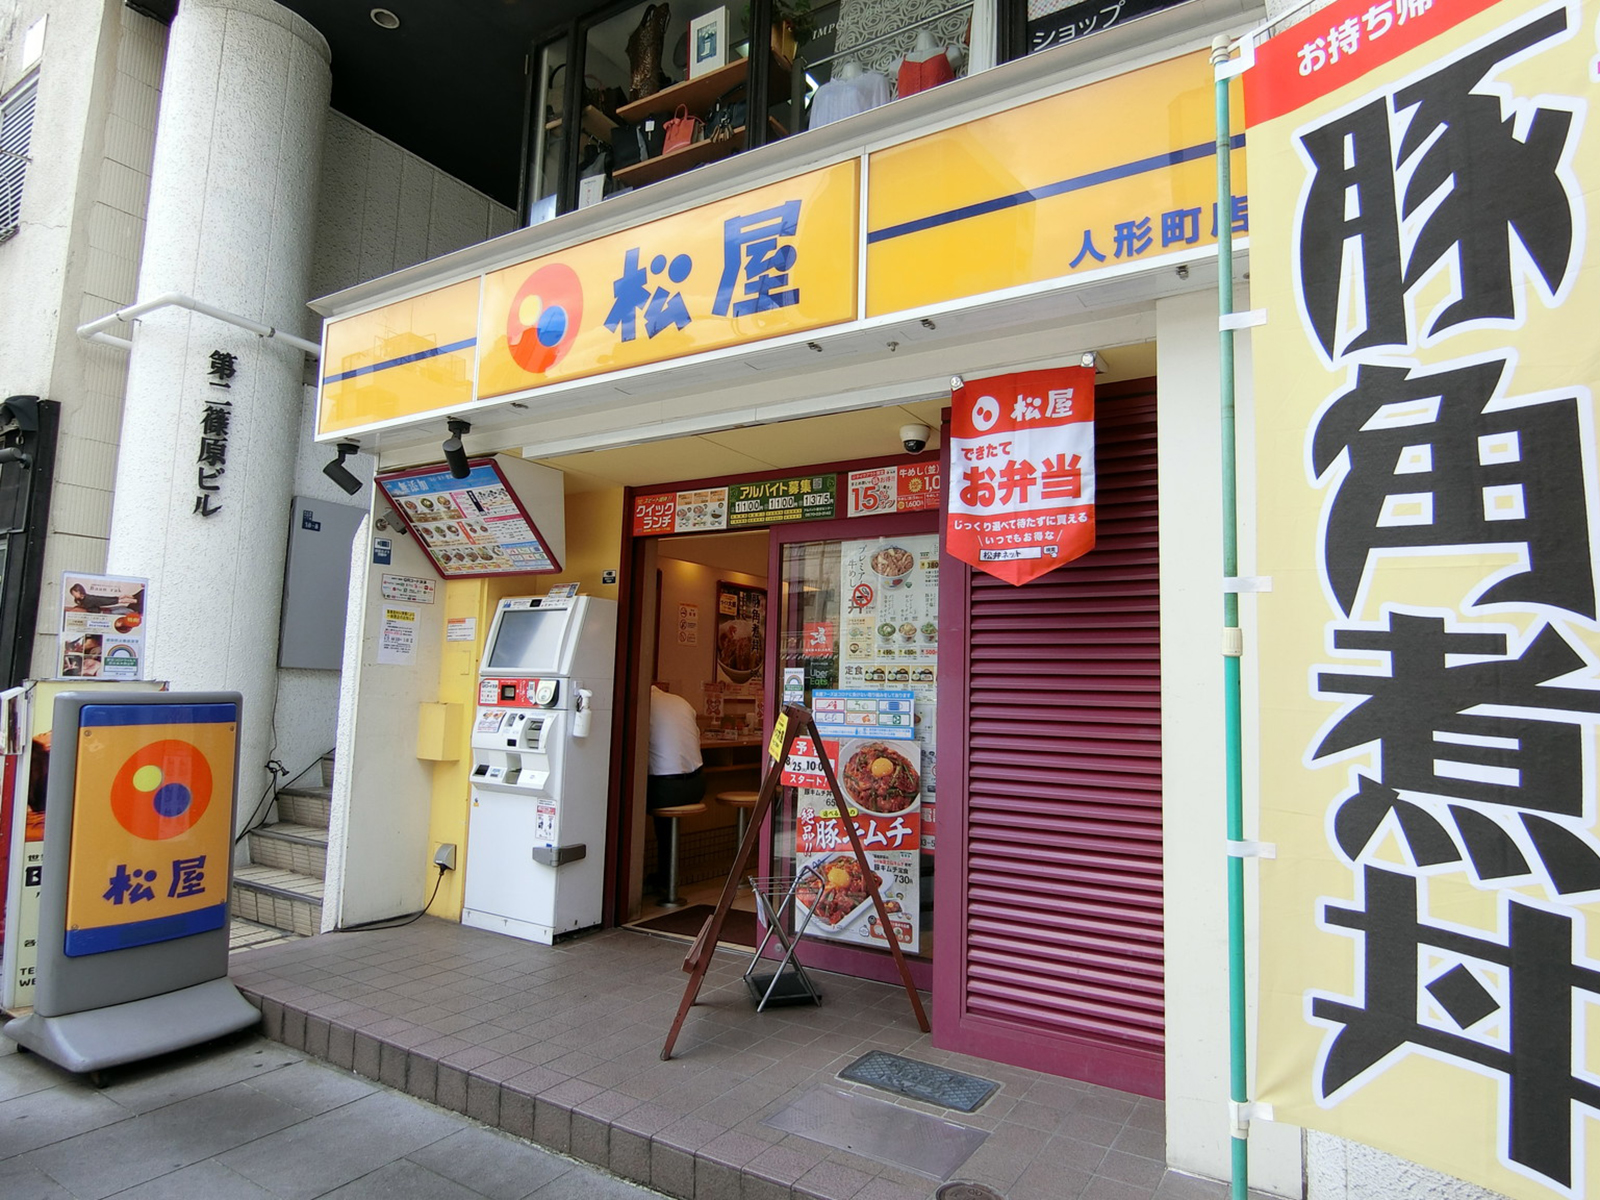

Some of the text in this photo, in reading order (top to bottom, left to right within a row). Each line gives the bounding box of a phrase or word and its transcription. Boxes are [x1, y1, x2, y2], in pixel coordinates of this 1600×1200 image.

[1033, 0, 1126, 51] ショップ
[603, 199, 802, 343] 松屋
[1010, 388, 1074, 422] 松屋
[192, 350, 238, 517] 第二篠原ビル
[961, 441, 1012, 461] できたて
[740, 479, 811, 499] アルバイト募集
[960, 453, 1082, 507] お弁当
[852, 486, 878, 511] 15
[636, 502, 675, 517] クイック
[643, 515, 672, 529] ランチ
[954, 512, 1088, 532] じっくり選べて待たずに買える
[985, 531, 1055, 545] いつでもお得な
[848, 559, 857, 588] 牛めし
[1299, 6, 1600, 1189] 豚角煮丼
[810, 669, 828, 678] Uber
[845, 665, 863, 675] 定食
[810, 678, 828, 686] Eats
[789, 774, 828, 787] スタート!
[826, 798, 836, 807] 65
[103, 855, 206, 905] 松屋
